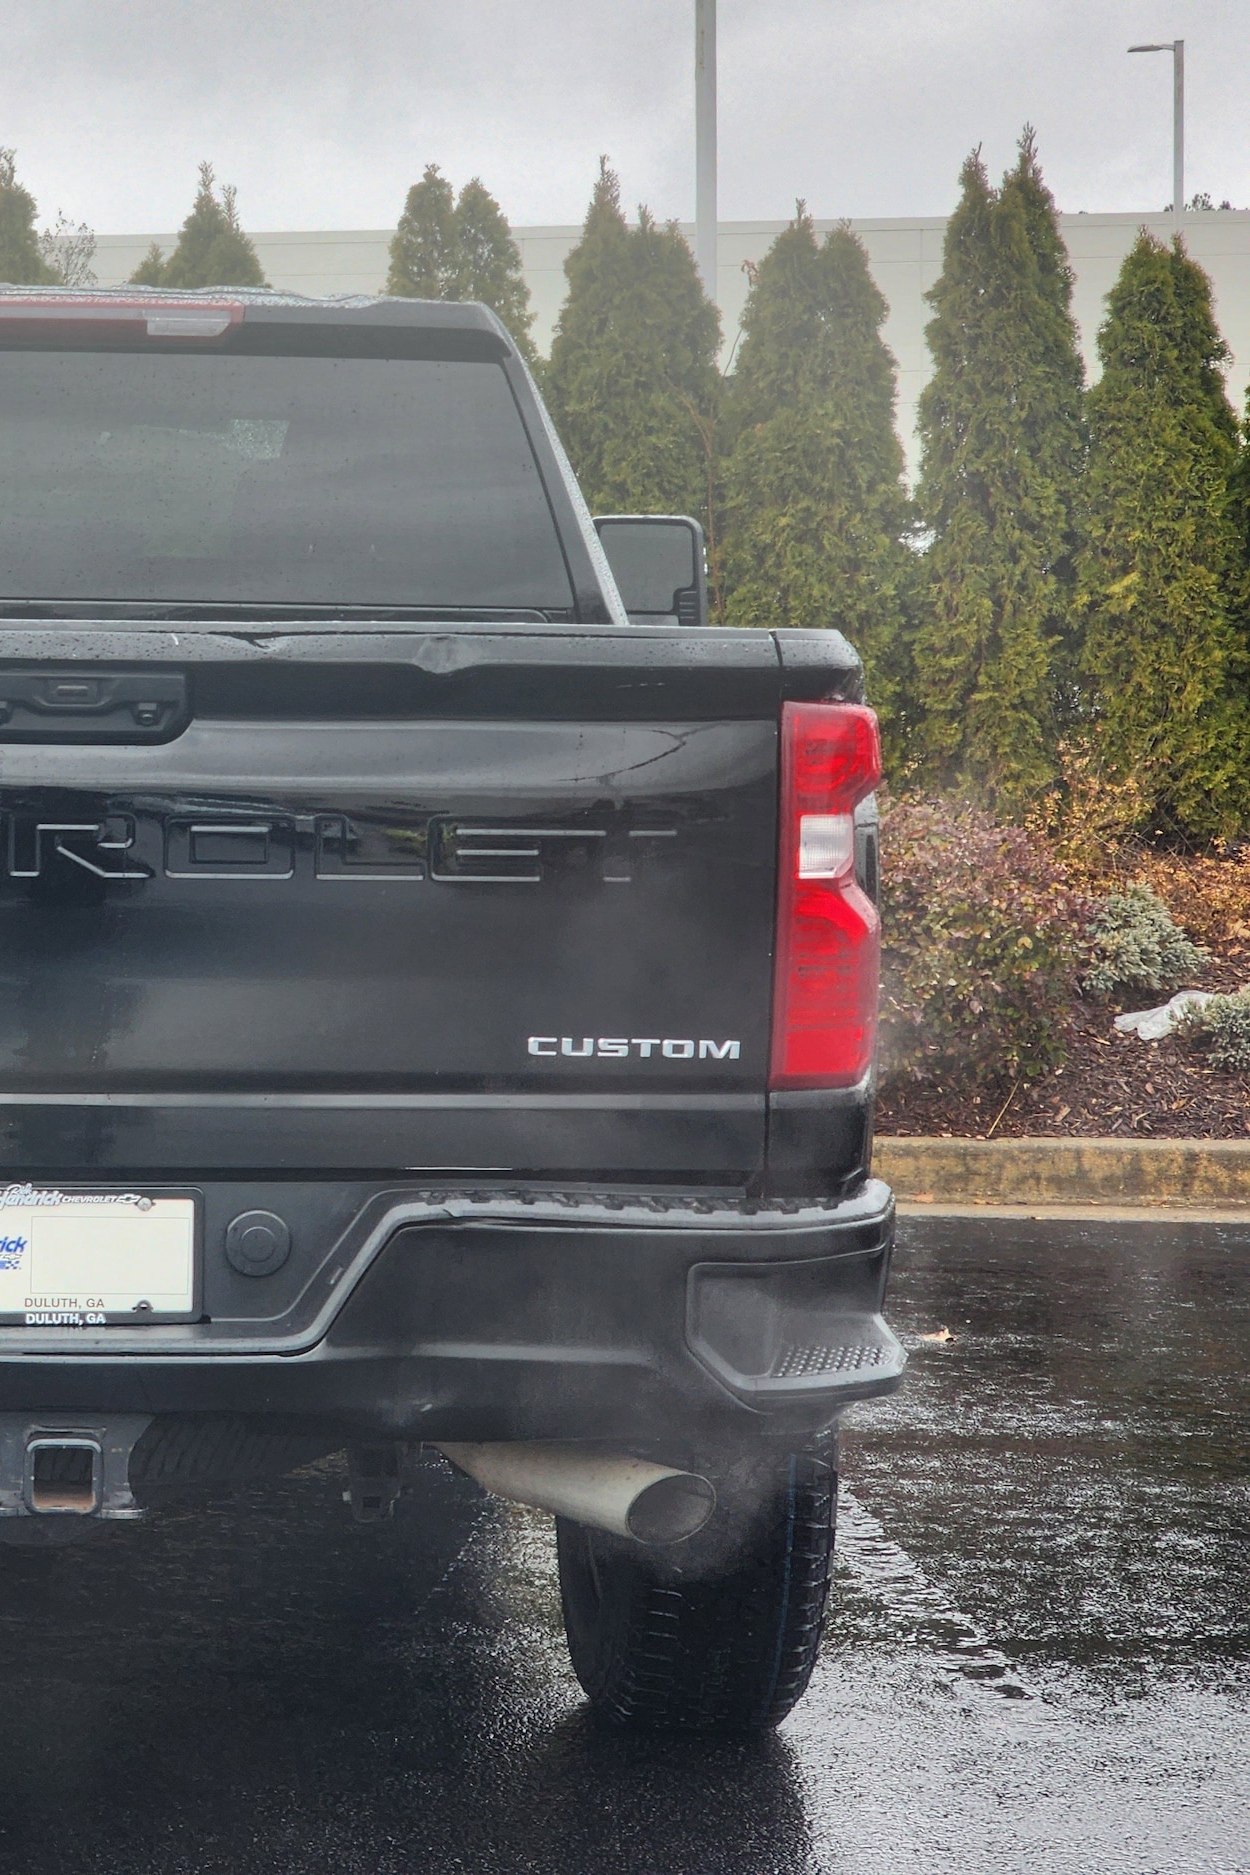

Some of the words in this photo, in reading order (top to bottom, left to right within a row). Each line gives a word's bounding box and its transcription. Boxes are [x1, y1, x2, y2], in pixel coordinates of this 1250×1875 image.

[527, 1036, 741, 1060] CUSTOM
[62, 1195, 117, 1204] CHEVROLET
[24, 1297, 82, 1310] DULUTH,
[86, 1298, 105, 1309] GA
[25, 1312, 84, 1326] DULUTH,
[85, 1314, 106, 1325] GA
